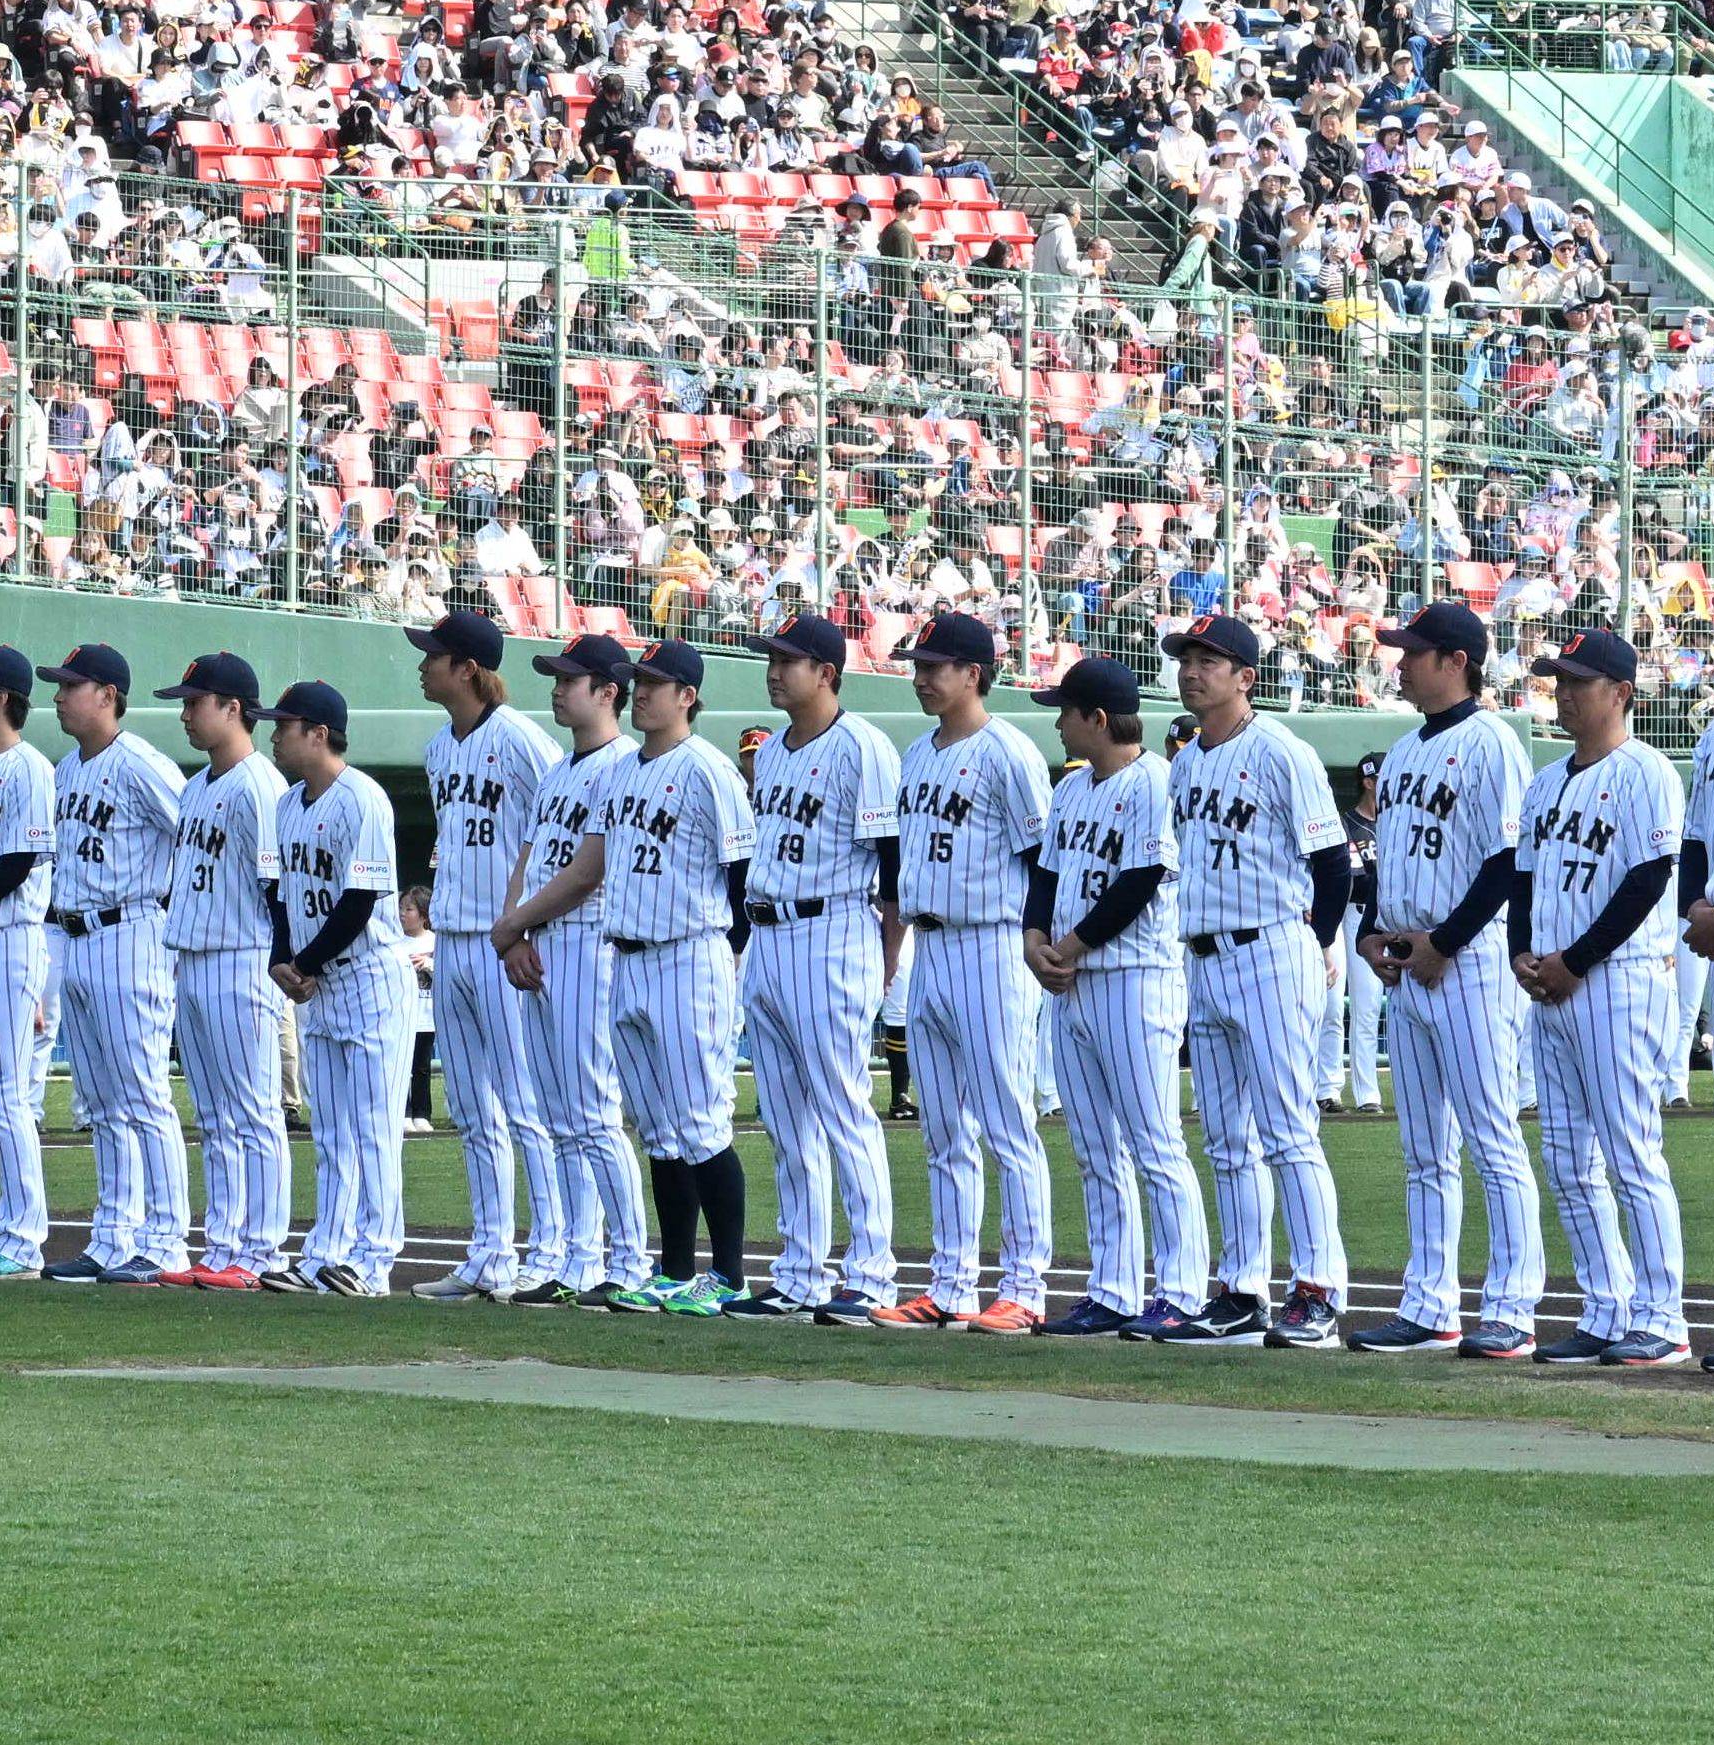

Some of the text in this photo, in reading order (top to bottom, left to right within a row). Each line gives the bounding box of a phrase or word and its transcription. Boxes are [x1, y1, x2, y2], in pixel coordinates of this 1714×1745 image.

[437, 773, 504, 813] APAN
[754, 785, 824, 829] APAN
[897, 783, 973, 828] APAN
[1173, 786, 1257, 834] APAN
[1376, 772, 1457, 821] APAN
[56, 792, 115, 832] APAN
[536, 795, 589, 835] APAN
[604, 795, 677, 844] APAN
[175, 817, 226, 859] APAN
[465, 818, 495, 847] 28
[777, 833, 805, 865] 19
[928, 832, 954, 863] 15
[1056, 820, 1125, 866] APAN
[1408, 824, 1443, 860] 79
[1534, 807, 1616, 856] APAN
[76, 837, 105, 864] 46
[279, 842, 334, 881] APAN
[543, 838, 575, 869] 26
[632, 844, 662, 876] 22
[1210, 839, 1240, 871] 71
[192, 864, 215, 894] 31
[366, 865, 388, 875] MUFG
[1080, 869, 1109, 902] 13
[1562, 859, 1598, 894] 77
[304, 890, 332, 918] 30
